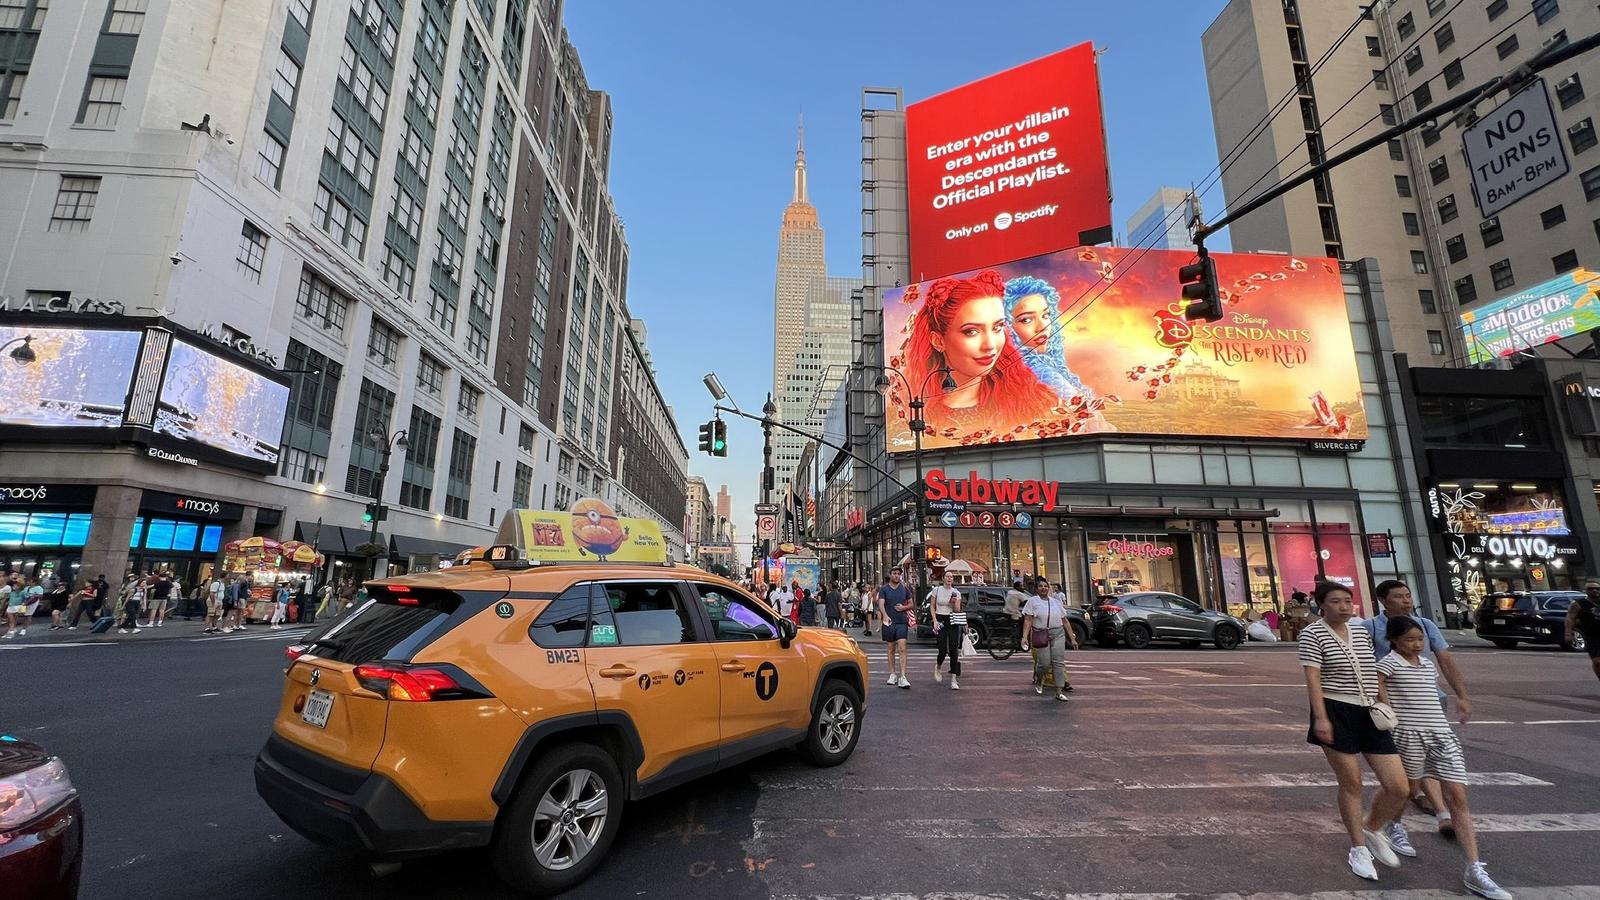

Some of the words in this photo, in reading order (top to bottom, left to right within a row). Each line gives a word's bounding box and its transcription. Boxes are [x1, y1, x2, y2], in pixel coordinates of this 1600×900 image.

[927, 135, 971, 160] Enter
[972, 123, 1013, 148] your
[1014, 105, 1070, 132] villain
[1485, 109, 1525, 149] NO
[945, 155, 972, 171] era
[975, 140, 1015, 162] with
[1017, 131, 1050, 149] the
[1477, 127, 1551, 182] TURNS
[941, 146, 1057, 190] Descendants
[932, 180, 995, 209] Official
[997, 162, 1071, 192] Playlist.
[945, 225, 973, 240] Only
[973, 222, 989, 234] on
[1014, 204, 1058, 223] Spotify
[1229, 311, 1269, 328] Disney
[1489, 295, 1561, 330] Modelo
[1163, 318, 1312, 343] DESCENDANTS
[1523, 316, 1576, 343] FRESCAS
[1212, 341, 1254, 367] RISE
[1272, 345, 1307, 369] RED
[1314, 442, 1359, 450] SILVERCAST
[925, 469, 1059, 512] Subway
[953, 503, 965, 511] Ave
[1107, 538, 1141, 556] Riley
[1141, 542, 1174, 558] Rose
[1488, 536, 1547, 556] OLIVO
[546, 649, 580, 664] 8M23
[743, 671, 755, 679] NYC
